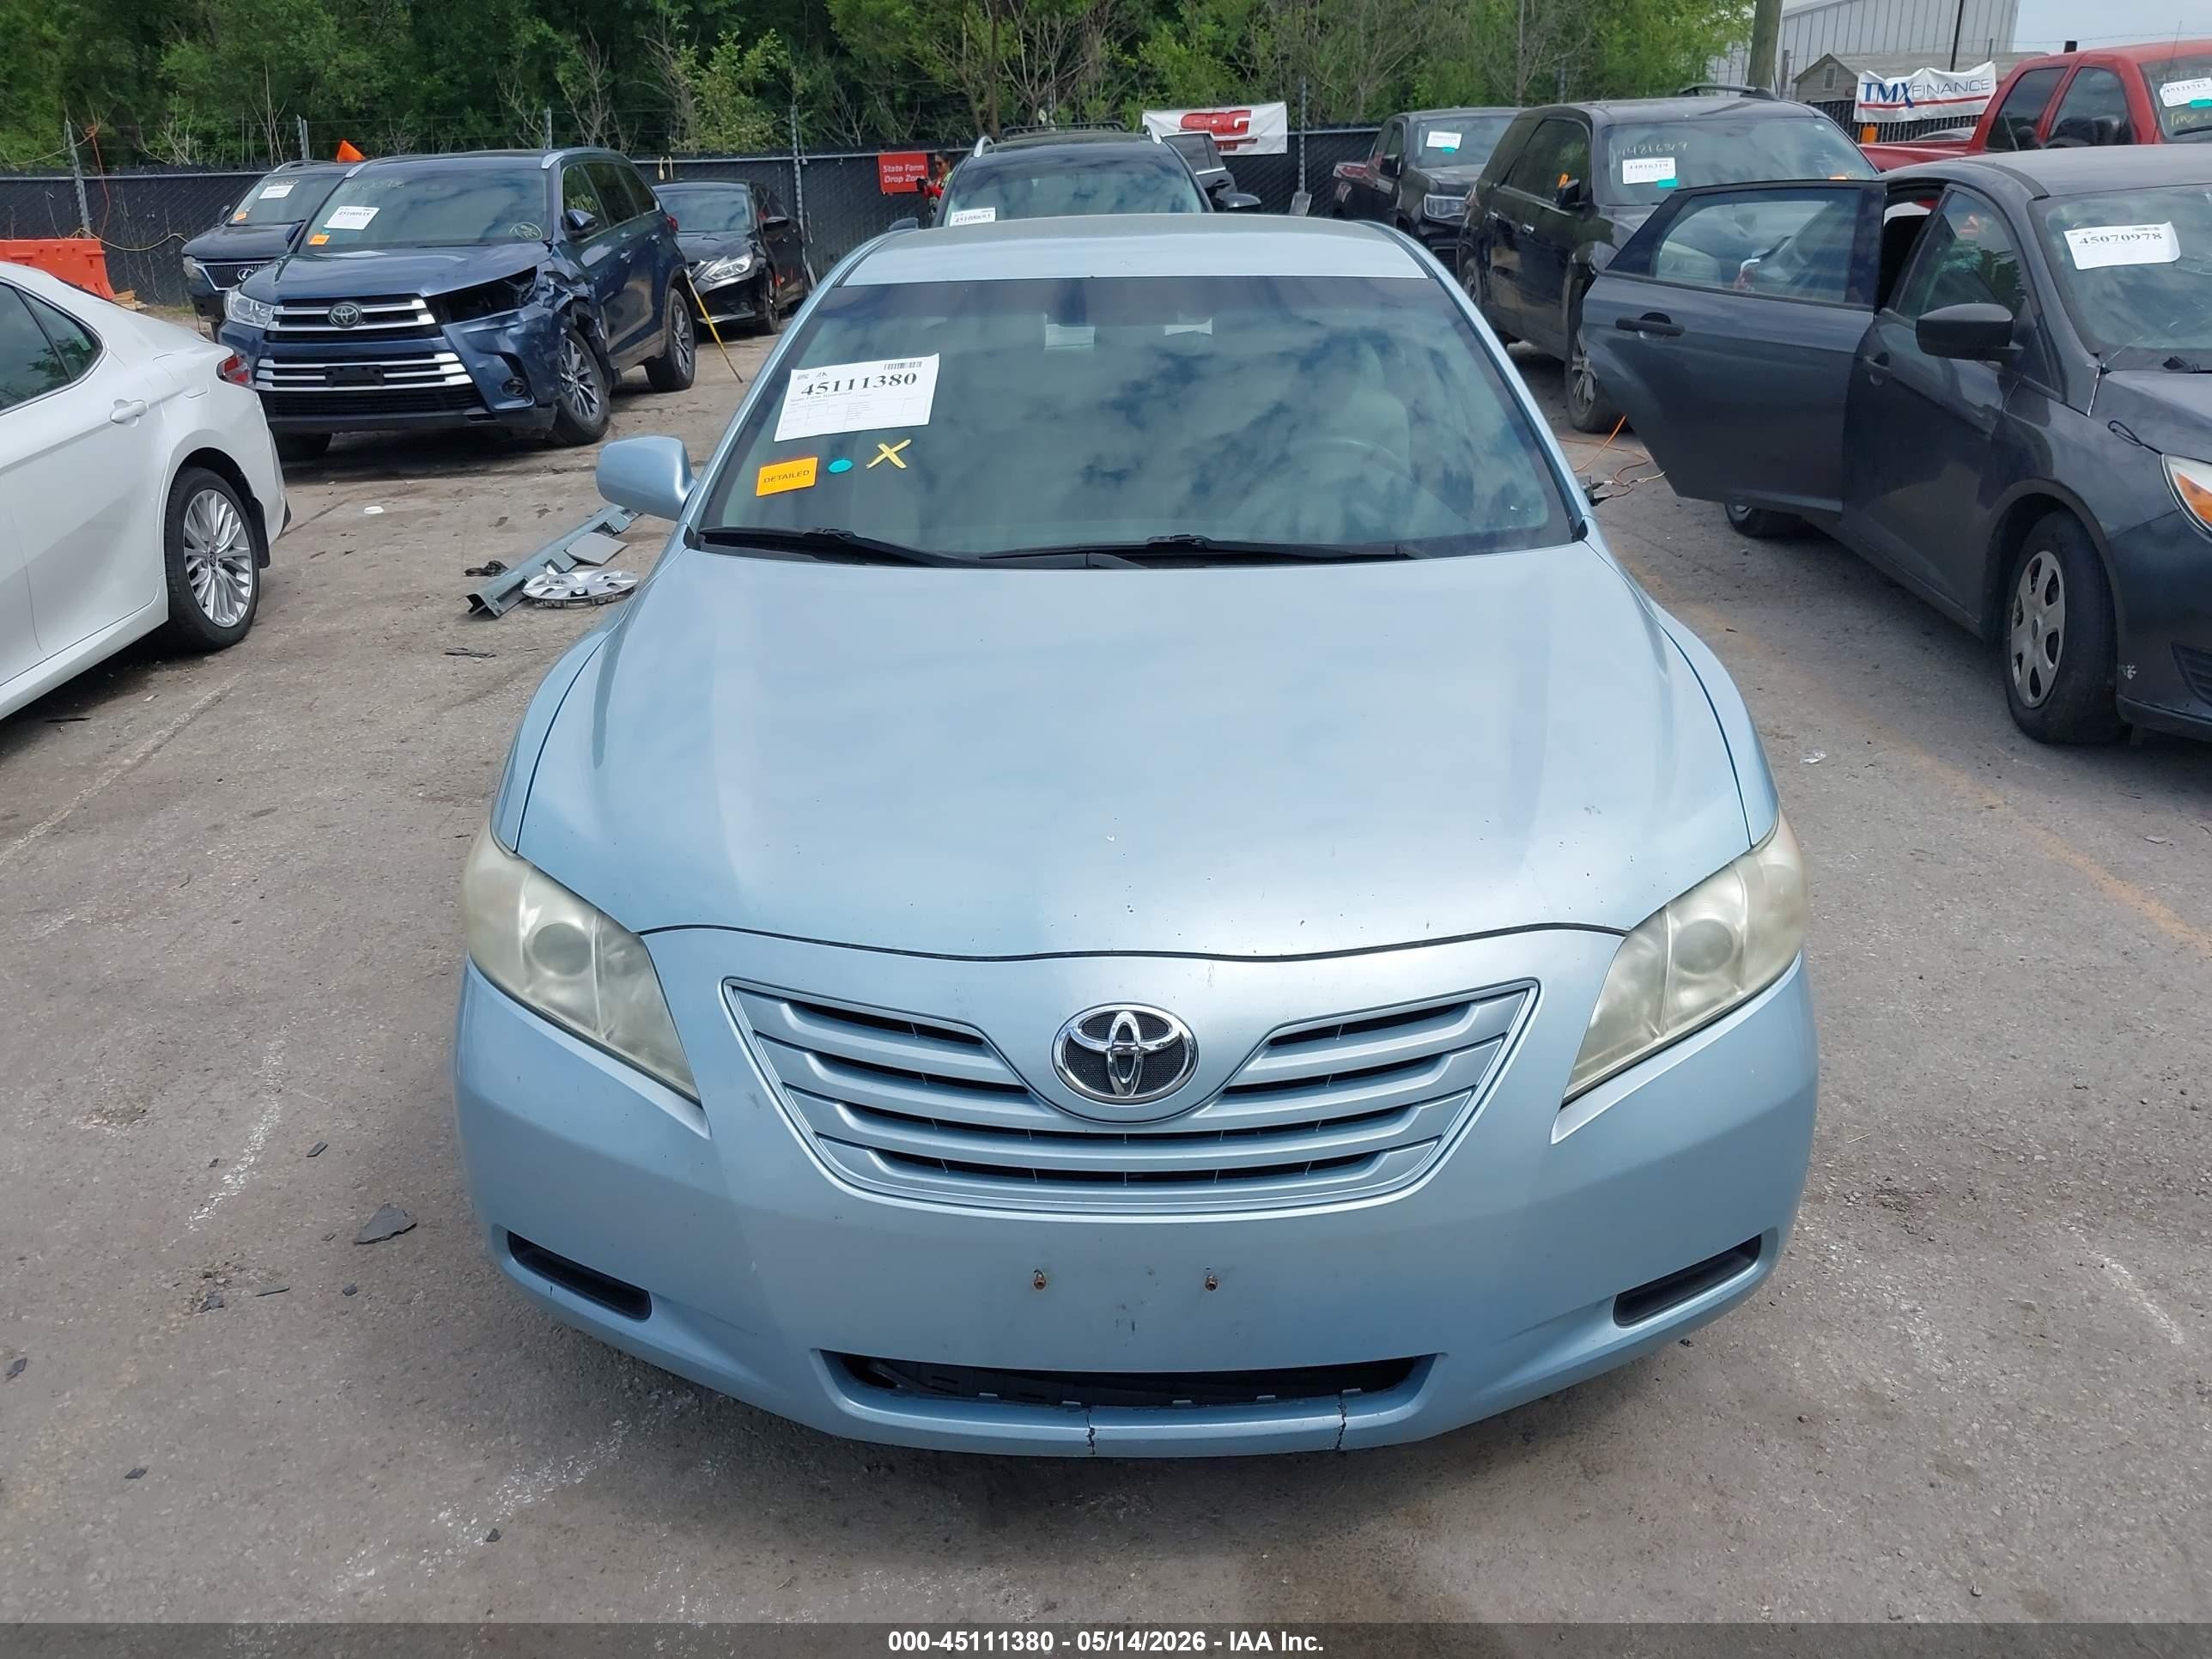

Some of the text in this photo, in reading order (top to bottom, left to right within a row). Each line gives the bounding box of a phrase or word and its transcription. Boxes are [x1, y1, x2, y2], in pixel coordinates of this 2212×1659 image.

[883, 165, 904, 173] State
[2079, 233, 2162, 245] 45070978
[799, 373, 917, 396] 45111380
[763, 470, 810, 483] DETAILED
